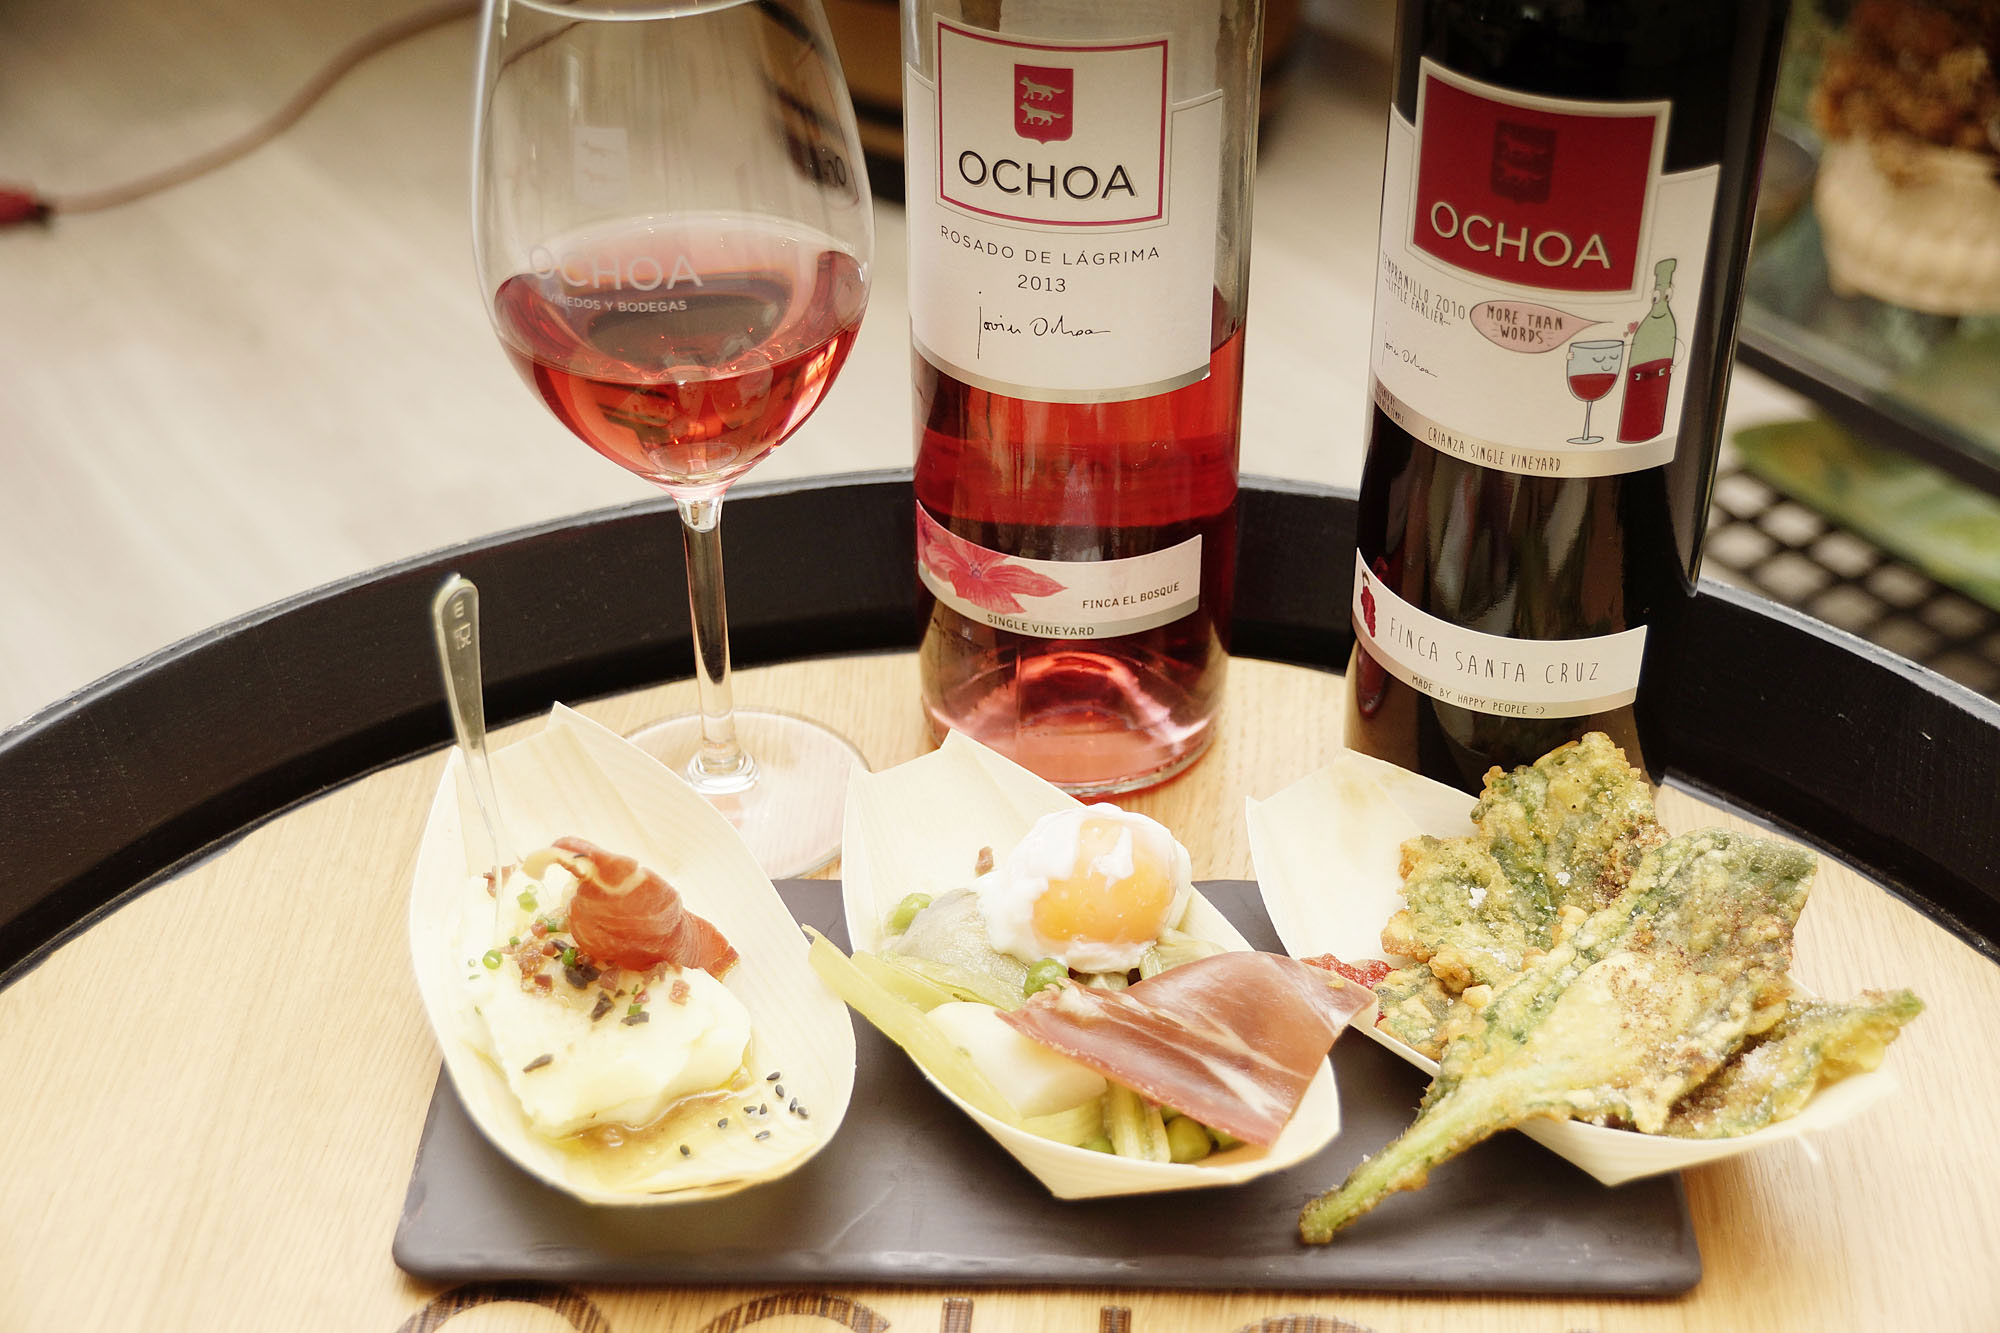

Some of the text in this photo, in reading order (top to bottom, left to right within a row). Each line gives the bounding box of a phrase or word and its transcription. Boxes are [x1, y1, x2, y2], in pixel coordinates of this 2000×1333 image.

[958, 150, 1137, 200] OCHOA
[940, 225, 1160, 266] ROSADO DE LÁGRIMA
[1430, 201, 1611, 269] OCHOA
[530, 244, 703, 291] OCHOA
[1017, 274, 1067, 293] 2013
[604, 301, 615, 311] Y
[617, 300, 688, 313] BODEGAS
[1435, 295, 1466, 320] 2010
[1486, 304, 1563, 330] MORE THAN
[1500, 325, 1544, 344] WORDS
[1428, 426, 1562, 472] CRIANZA SINGLE VINEYARD
[1082, 581, 1180, 609] FINCA EL BOSQUE
[986, 613, 1095, 636] SINGLE VINEYARD
[1389, 617, 1600, 684] FINCA SANTA CRUZ
[1411, 674, 1433, 693] MADE
[1439, 688, 1451, 699] BY
[1457, 694, 1486, 709] HAPPY
[1493, 702, 1528, 715] PEOPLE
